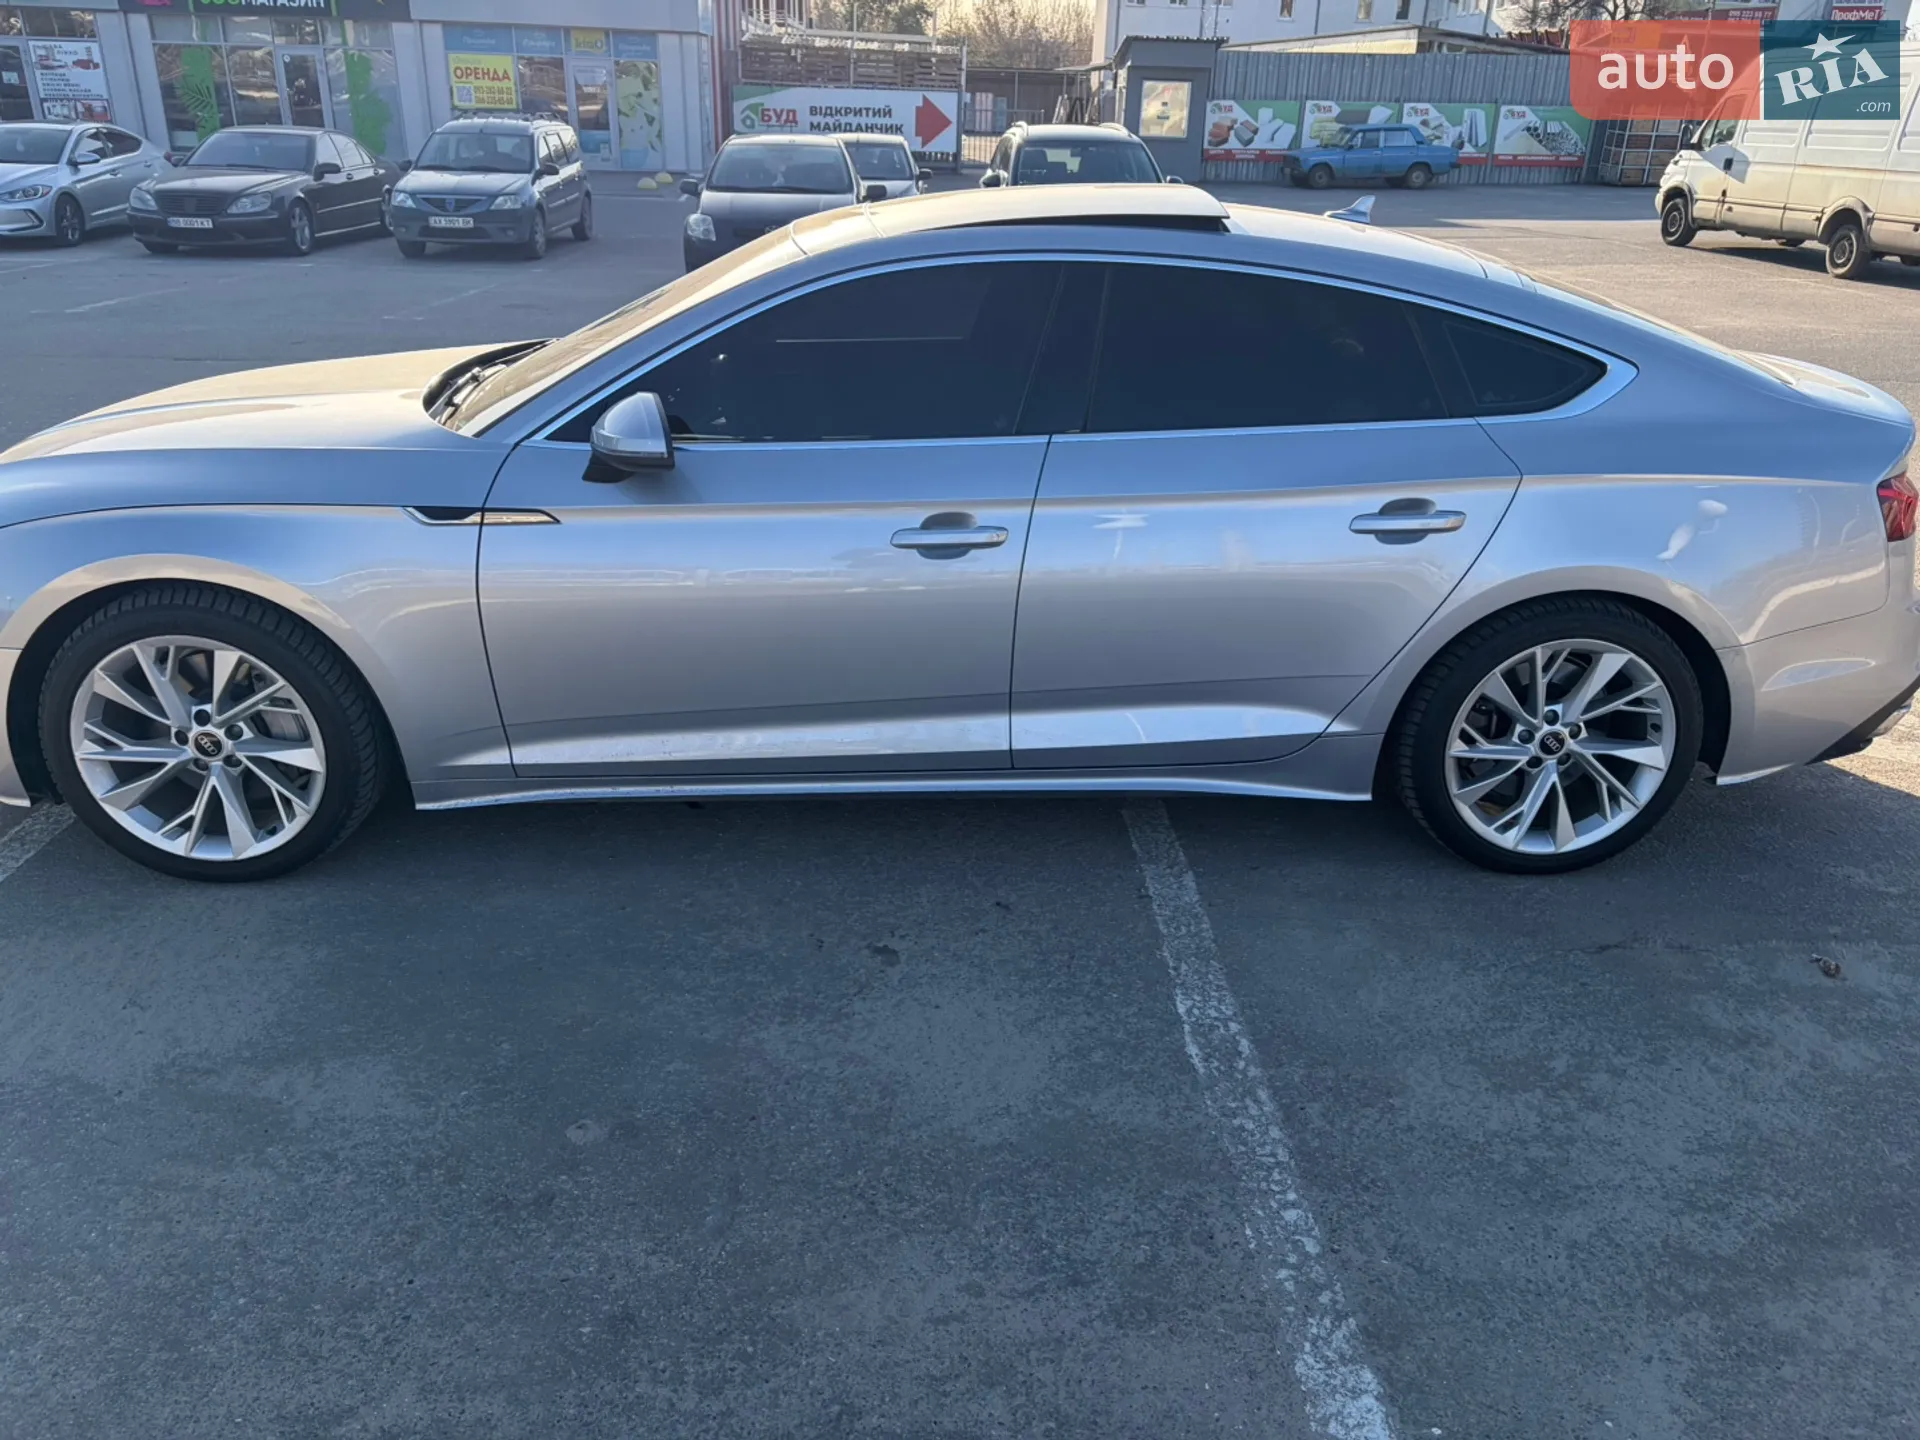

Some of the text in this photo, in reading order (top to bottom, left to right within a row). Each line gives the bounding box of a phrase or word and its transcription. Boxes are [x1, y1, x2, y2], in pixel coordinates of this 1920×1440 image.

[453, 66, 512, 82] ОРЕНДА
[809, 105, 892, 118] ВІДКРИТИЙ
[760, 108, 904, 134] БУД МАЙДАНЧИК
